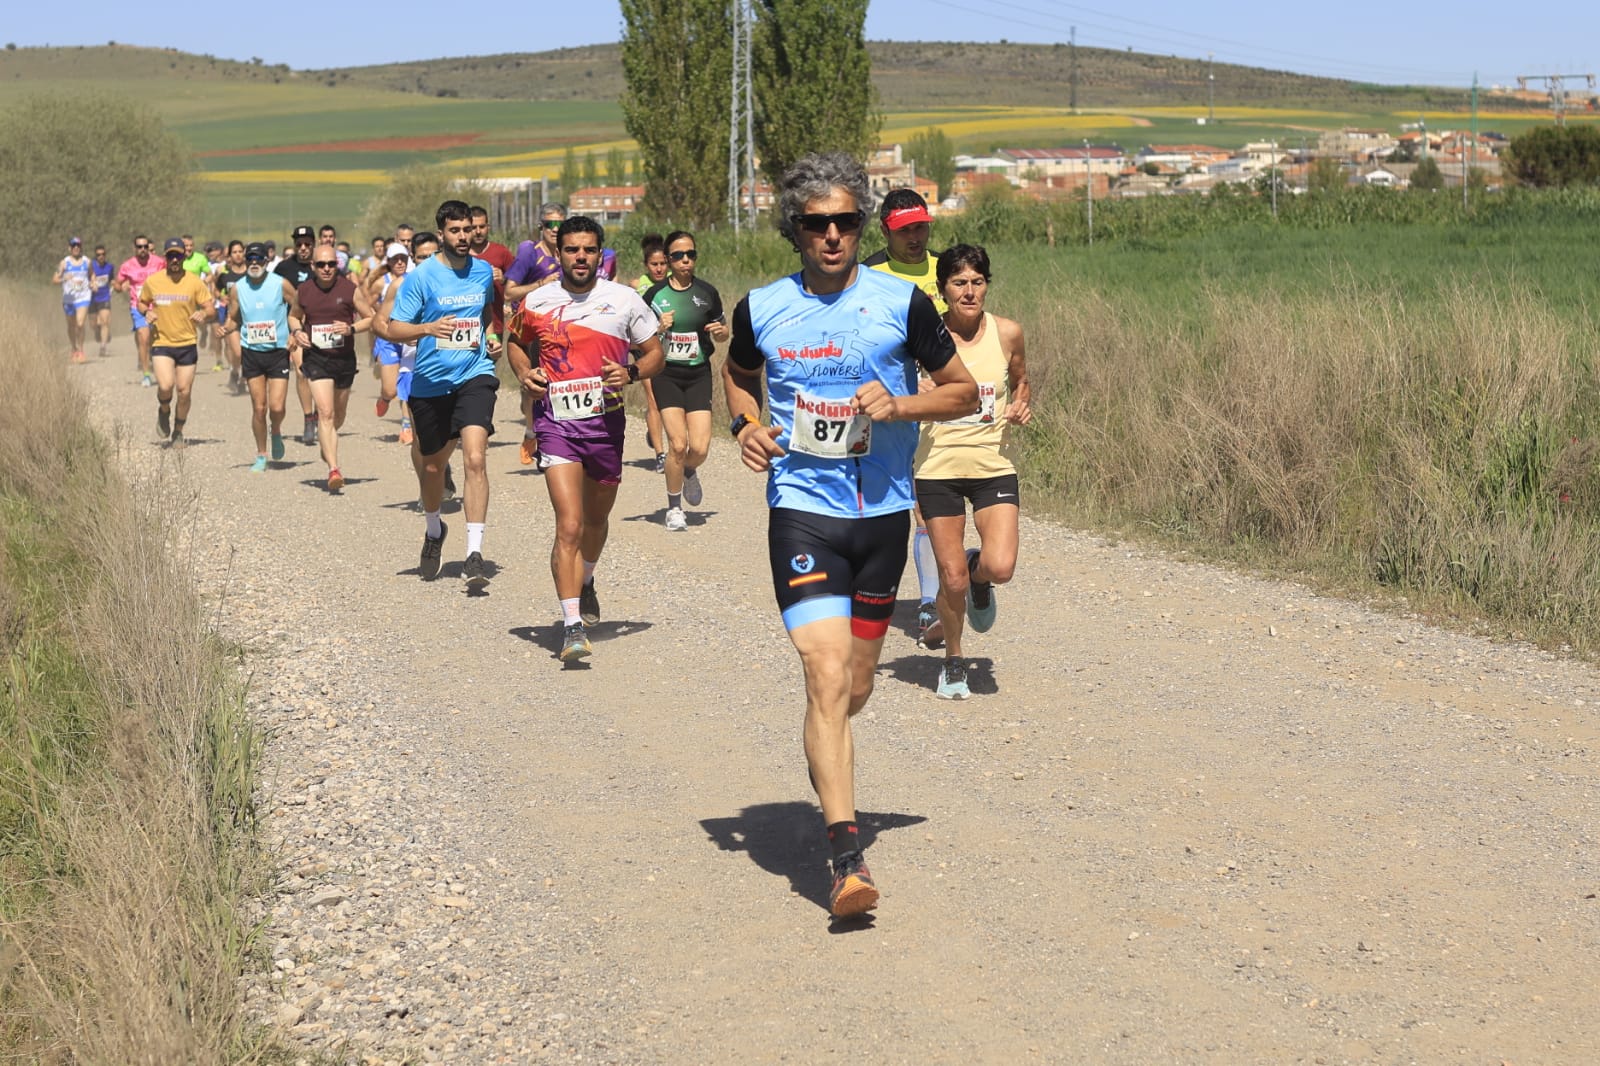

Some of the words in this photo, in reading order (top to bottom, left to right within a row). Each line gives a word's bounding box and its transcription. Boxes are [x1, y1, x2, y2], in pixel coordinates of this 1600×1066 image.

[437, 293, 486, 305] VIEWNEXT
[669, 343, 692, 353] 197
[812, 364, 860, 377] FLOWERS
[551, 381, 602, 394] bedunia
[562, 393, 593, 410] 116
[796, 394, 865, 417] bedun
[814, 419, 847, 443] 87
